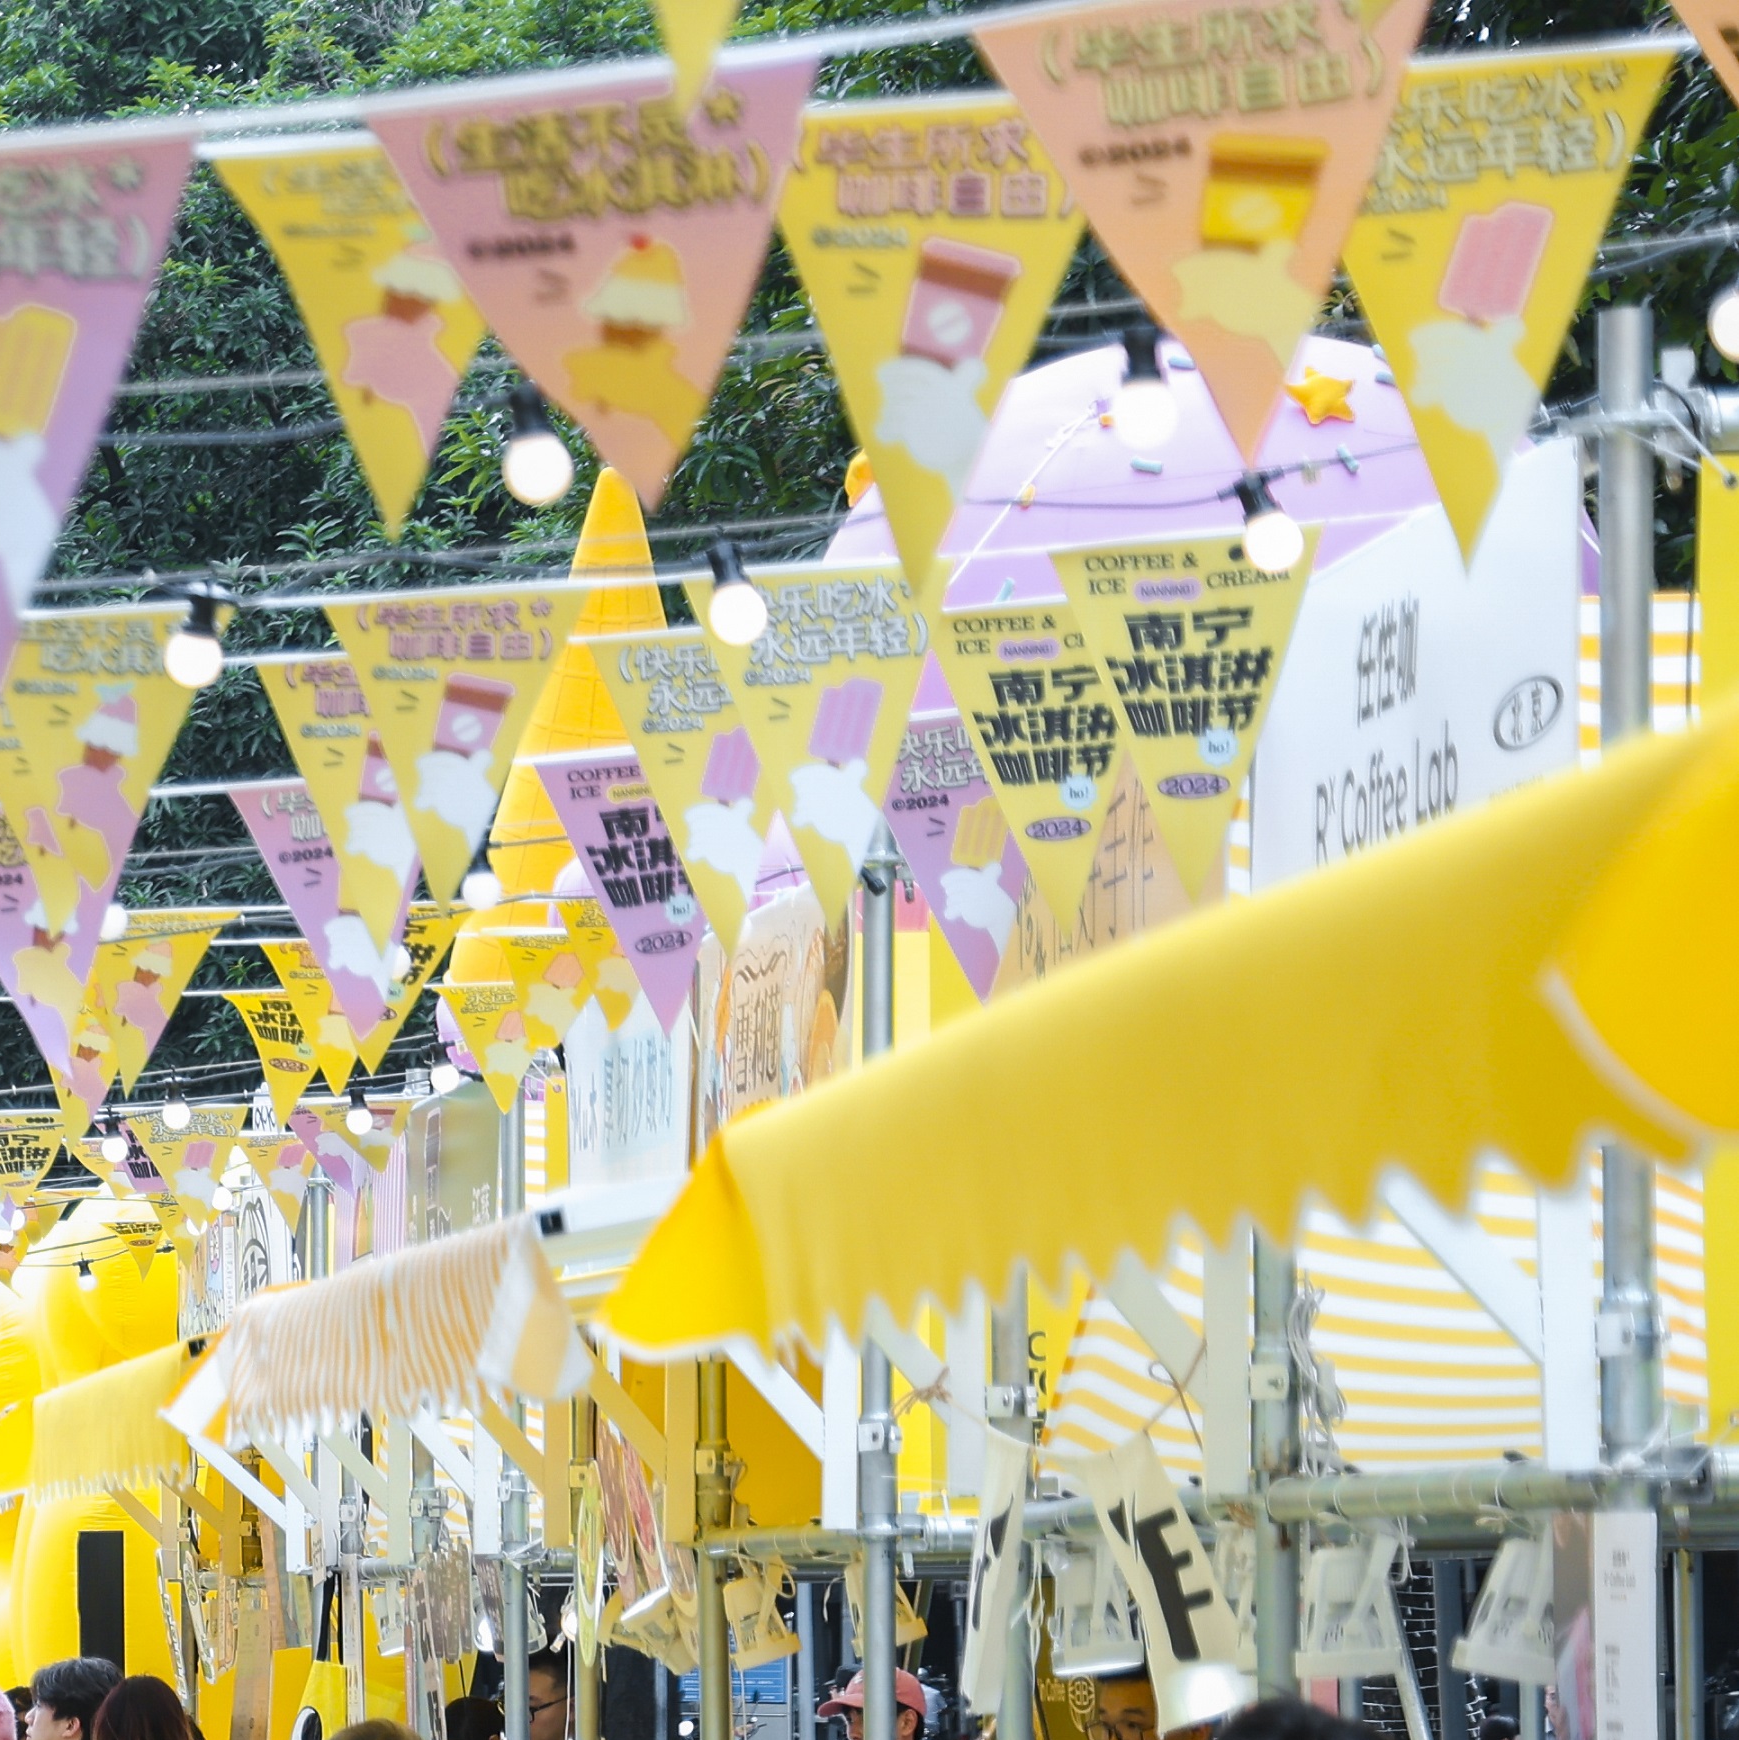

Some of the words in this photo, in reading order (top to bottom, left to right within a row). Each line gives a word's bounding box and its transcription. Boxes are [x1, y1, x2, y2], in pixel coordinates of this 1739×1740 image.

[1085, 553, 1176, 572] COFFEE
[1181, 553, 1200, 569] &
[1086, 575, 1127, 595] ICE
[1140, 583, 1195, 599] NANNING!
[1206, 566, 1291, 590] CREAM
[952, 616, 1031, 634] COFFEE
[1041, 616, 1056, 629] &
[1123, 607, 1254, 651] 南宁
[955, 638, 992, 656] ICE
[1003, 643, 1055, 659] NANNING!
[1114, 647, 1274, 697] 冰淇淋
[988, 666, 1101, 708] 南宁
[1127, 692, 1261, 739] 咖啡节
[974, 705, 1117, 749] 冰淇淋
[1207, 739, 1231, 756] ho!
[992, 742, 1117, 787] 咖啡节
[566, 766, 639, 784] COFFEE
[568, 784, 601, 800] ICE
[1068, 785, 1090, 801] ho!
[1163, 775, 1226, 796] 2024
[1341, 750, 1408, 856] Coffee
[1414, 720, 1460, 826] Lab
[1031, 819, 1085, 837] 2024
[670, 903, 691, 917] ho!
[643, 933, 685, 950] 2024
[272, 1059, 307, 1071] 2024
